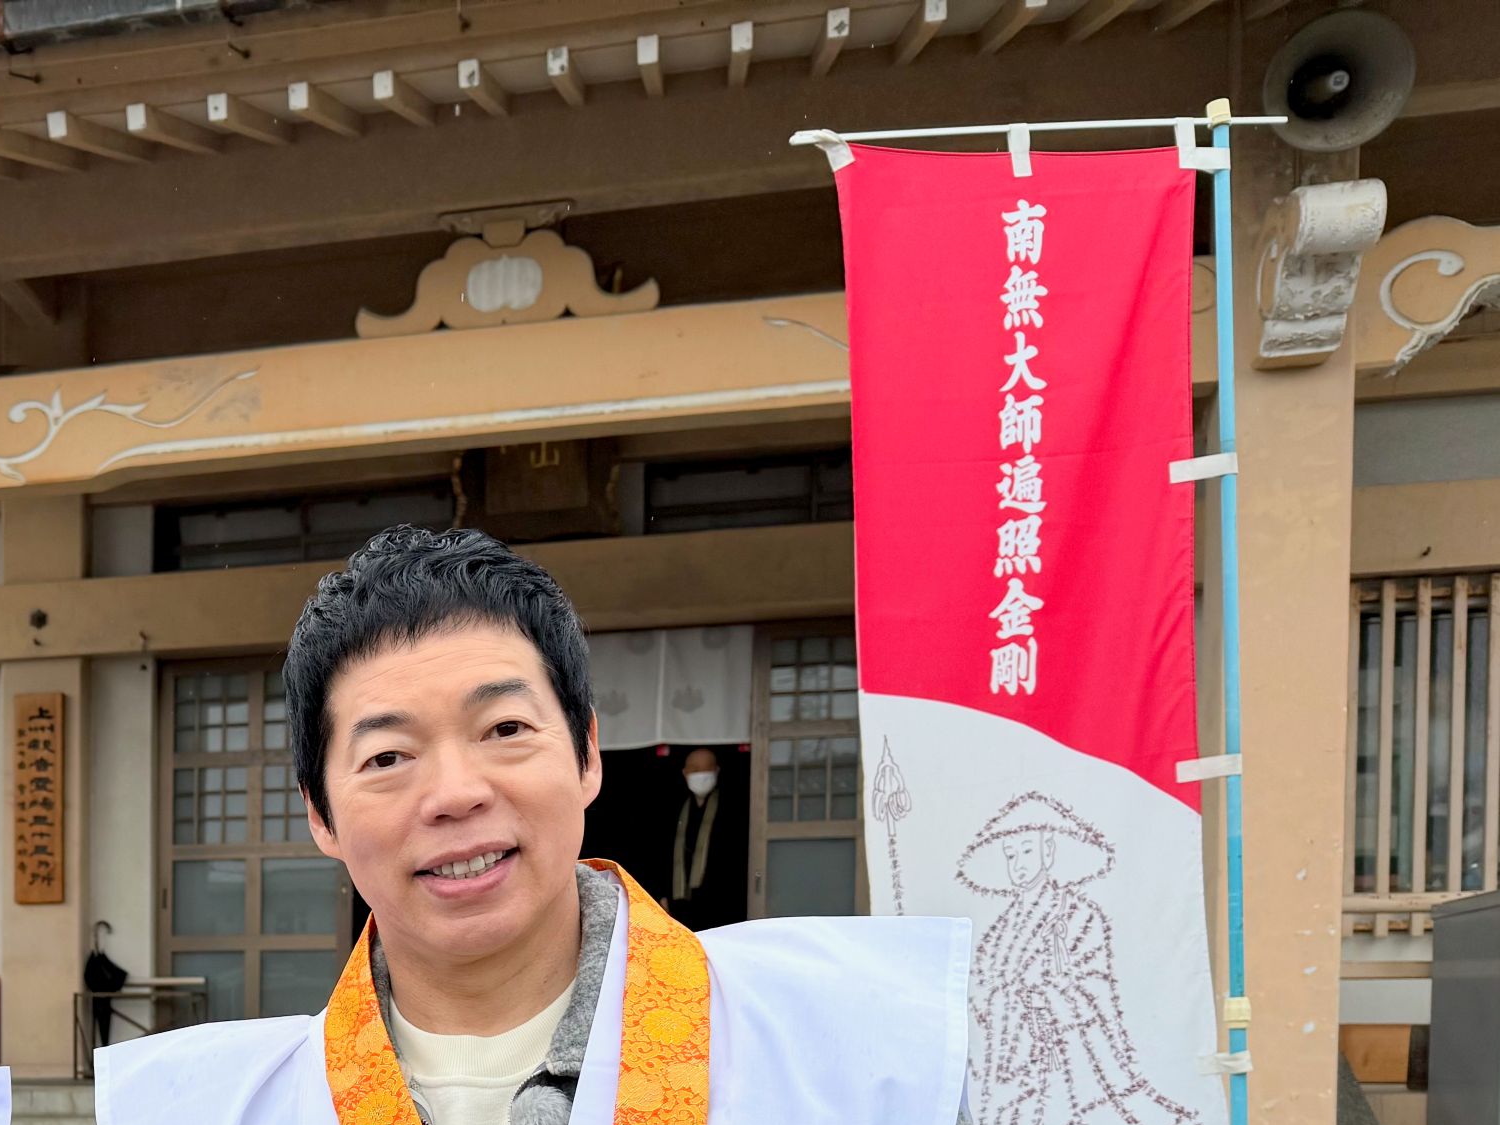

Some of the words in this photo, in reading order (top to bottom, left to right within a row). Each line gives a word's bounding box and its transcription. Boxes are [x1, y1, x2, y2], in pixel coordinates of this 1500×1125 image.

[989, 199, 1048, 696] 南無大師遍照金剛
